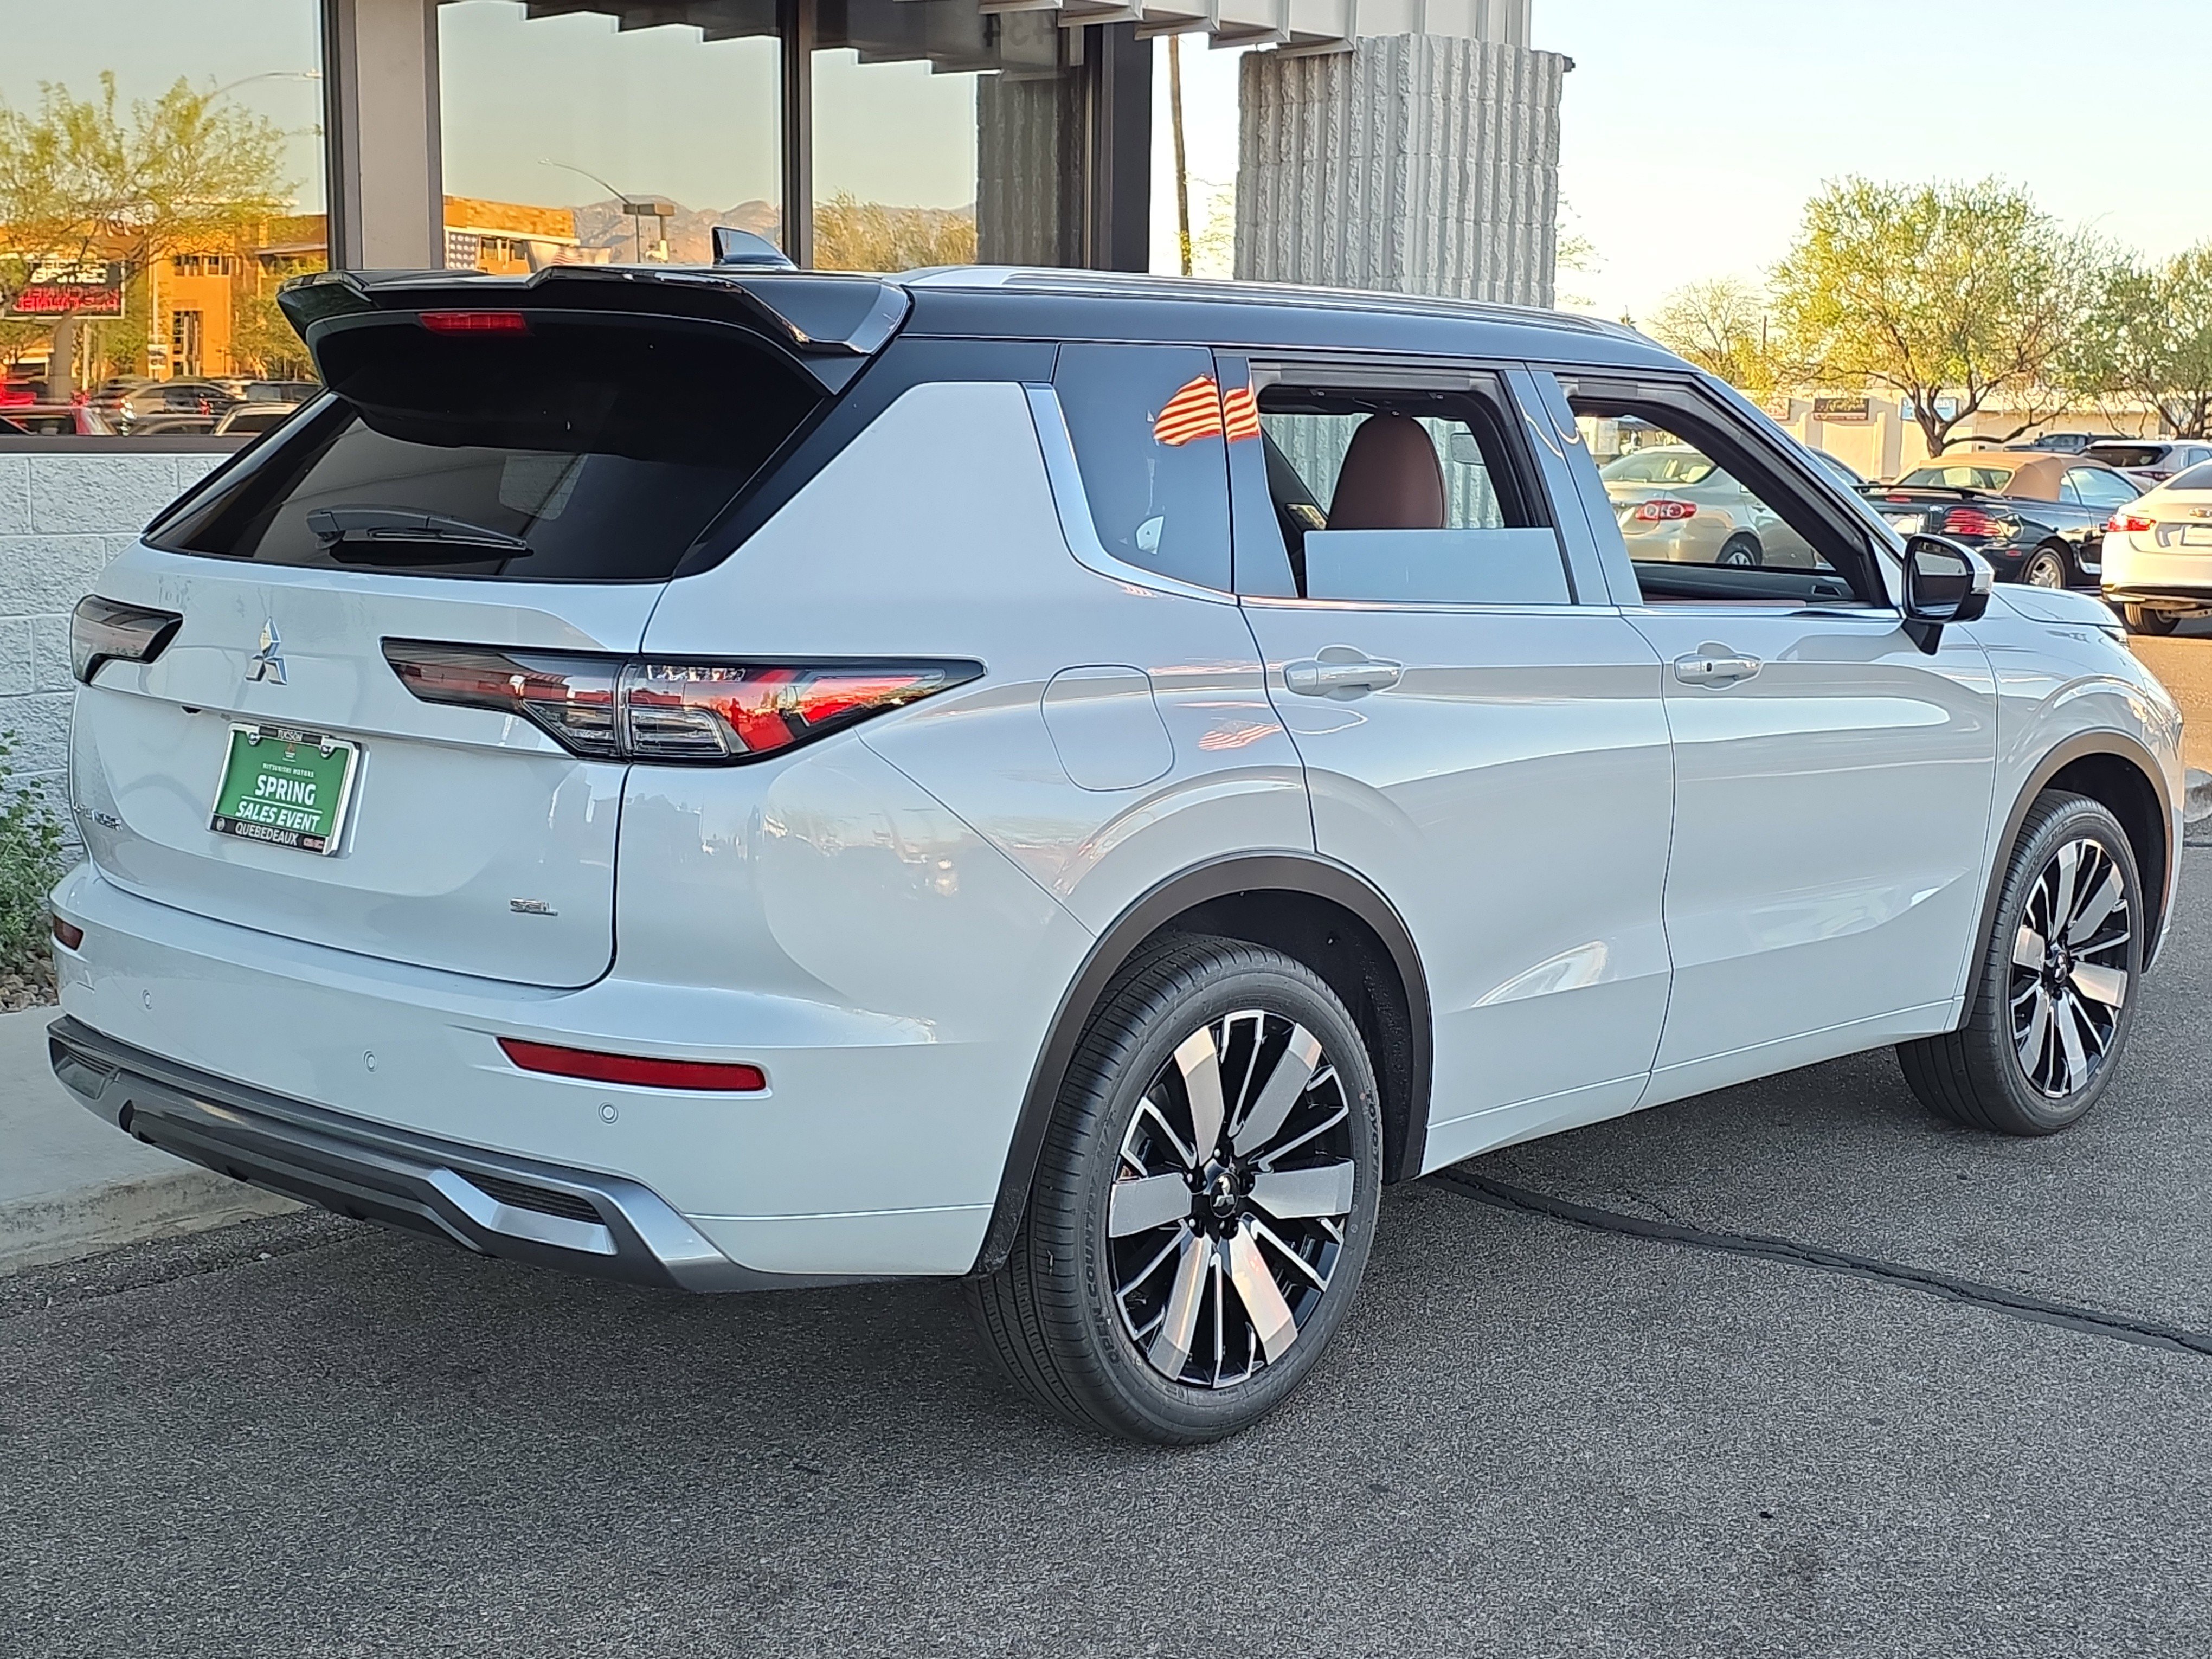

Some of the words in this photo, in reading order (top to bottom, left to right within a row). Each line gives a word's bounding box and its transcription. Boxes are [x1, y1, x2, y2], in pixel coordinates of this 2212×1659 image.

[278, 729, 303, 742] TUCSON
[255, 775, 316, 805] SPRING
[235, 801, 277, 823] SALES
[276, 809, 321, 832] EVENT
[235, 822, 299, 846] QUEBEDEAUX
[1084, 1176, 1098, 1298] COUNTRY
[1092, 1307, 1120, 1365] OPEN
